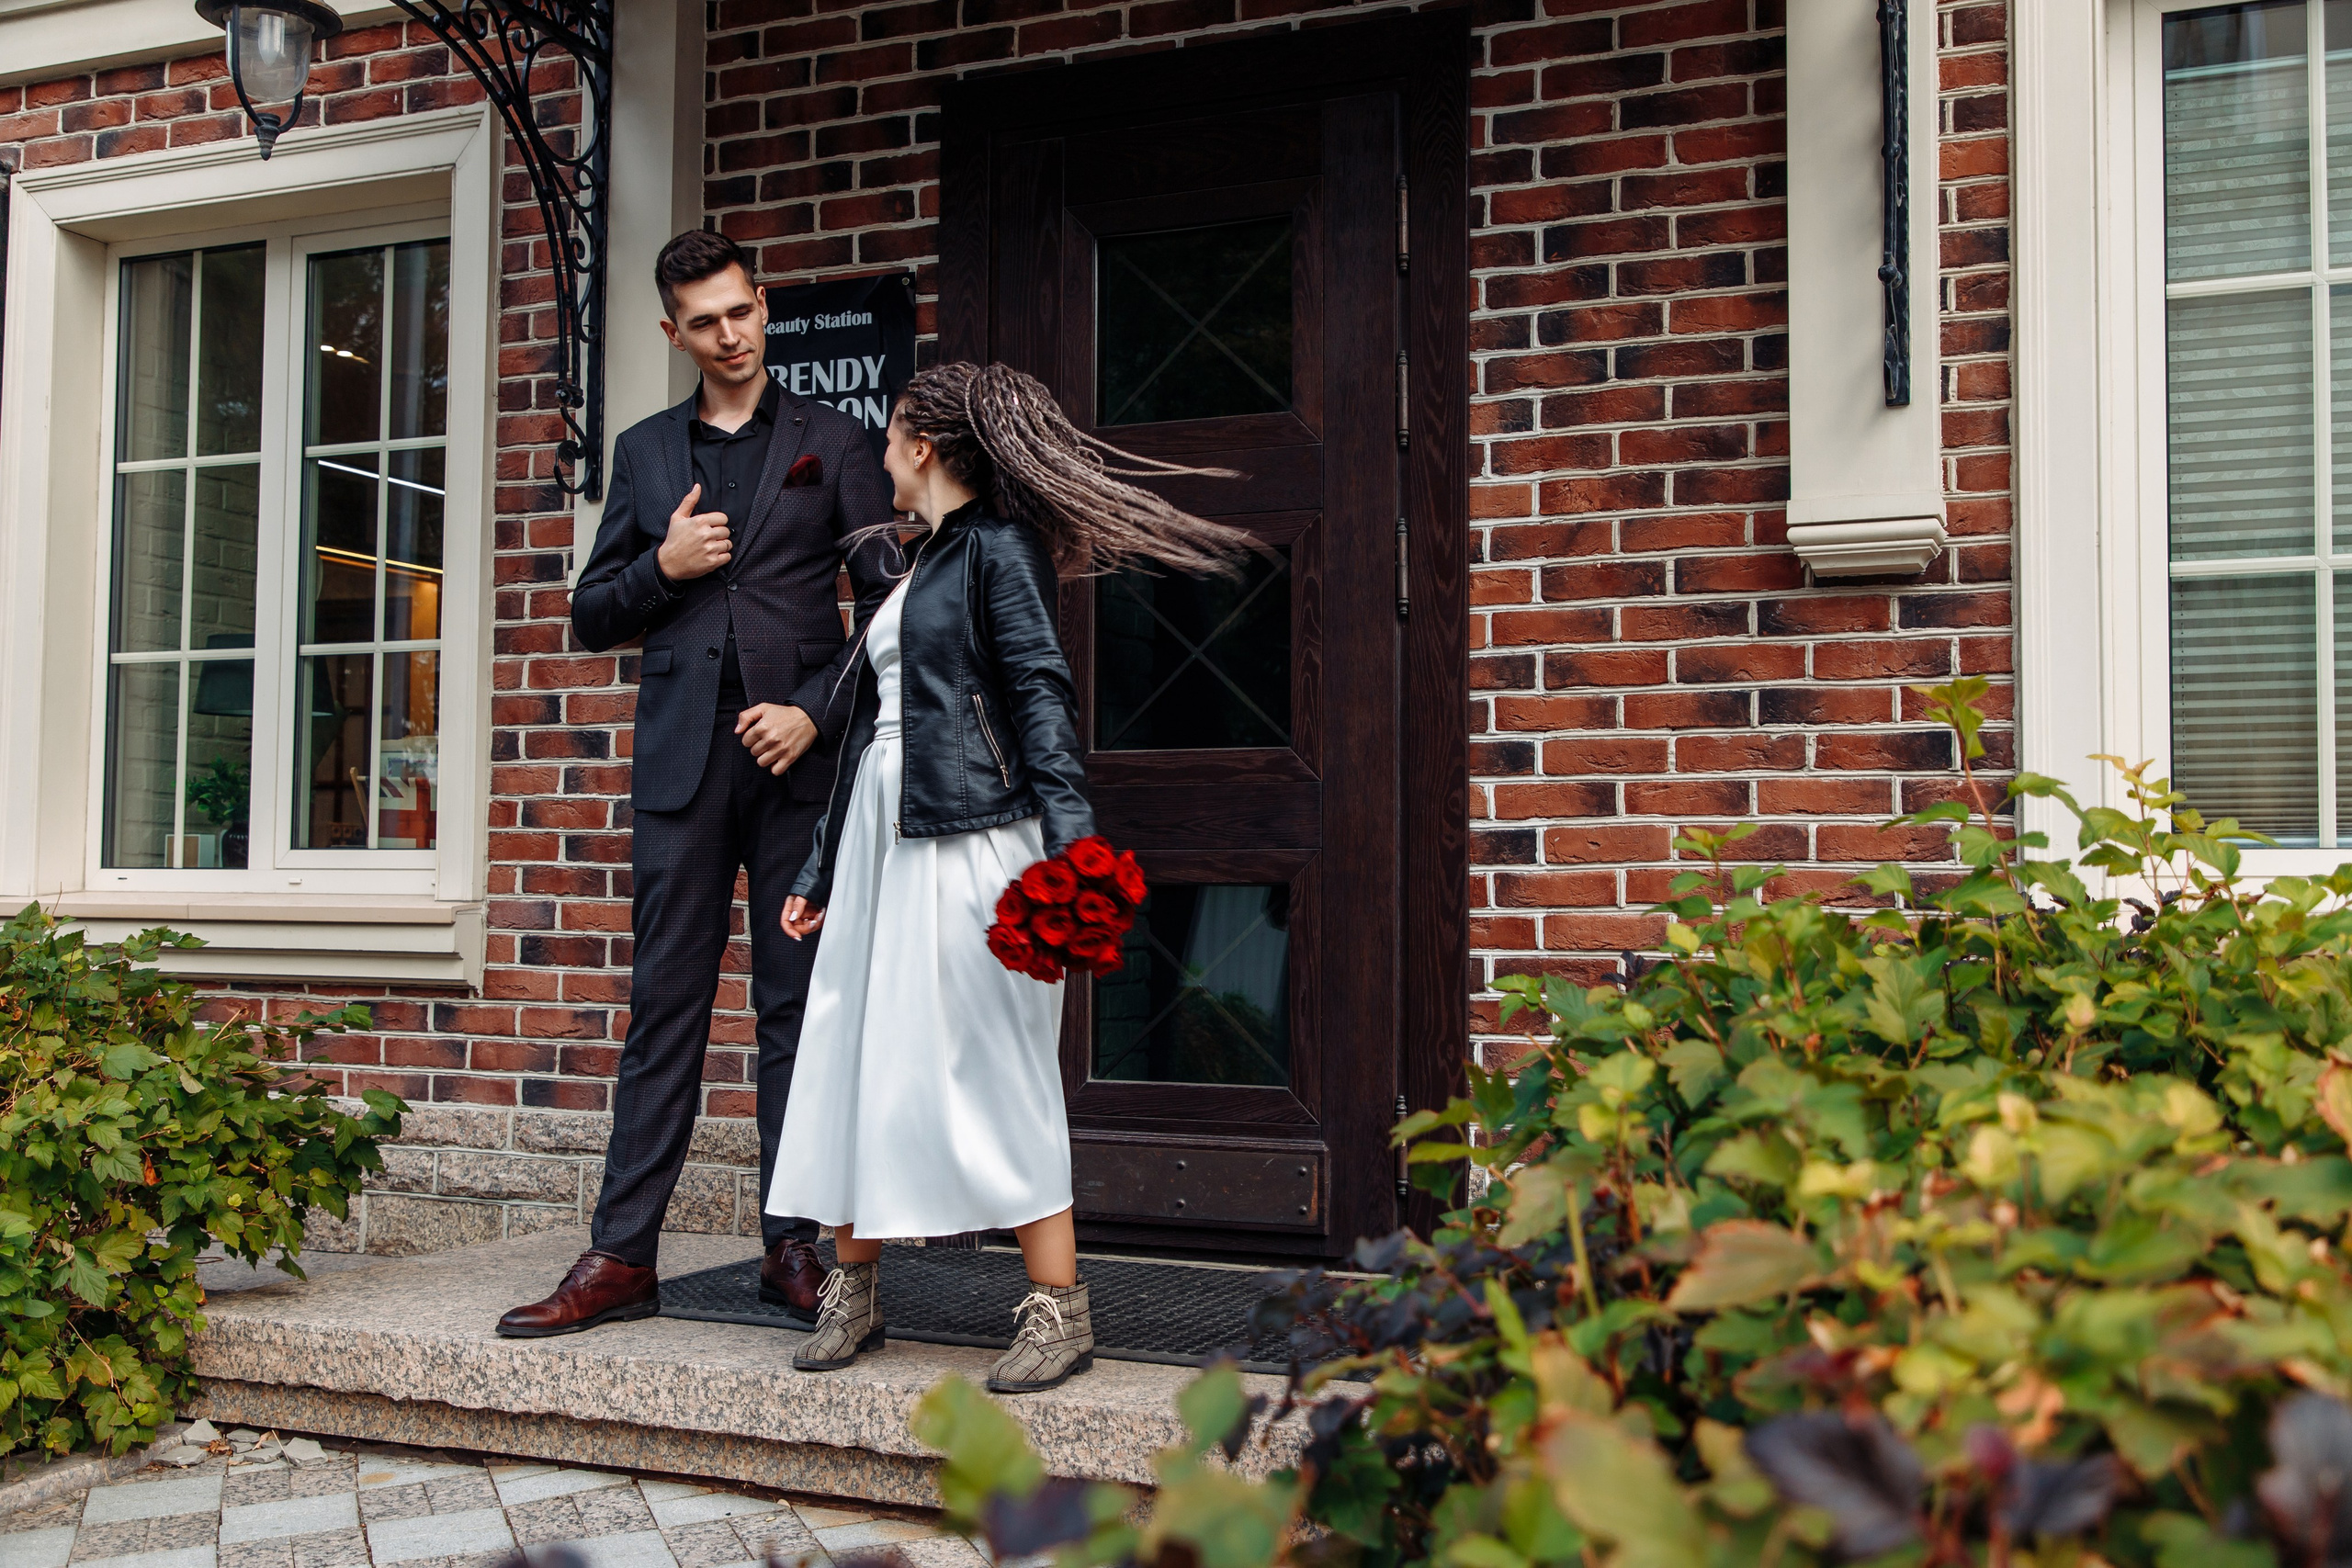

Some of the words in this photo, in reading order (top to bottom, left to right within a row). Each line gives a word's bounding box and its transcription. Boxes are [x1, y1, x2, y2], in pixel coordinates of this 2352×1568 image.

[763, 317, 810, 334] eauty
[814, 310, 873, 330] Station
[817, 394, 888, 430] ON
